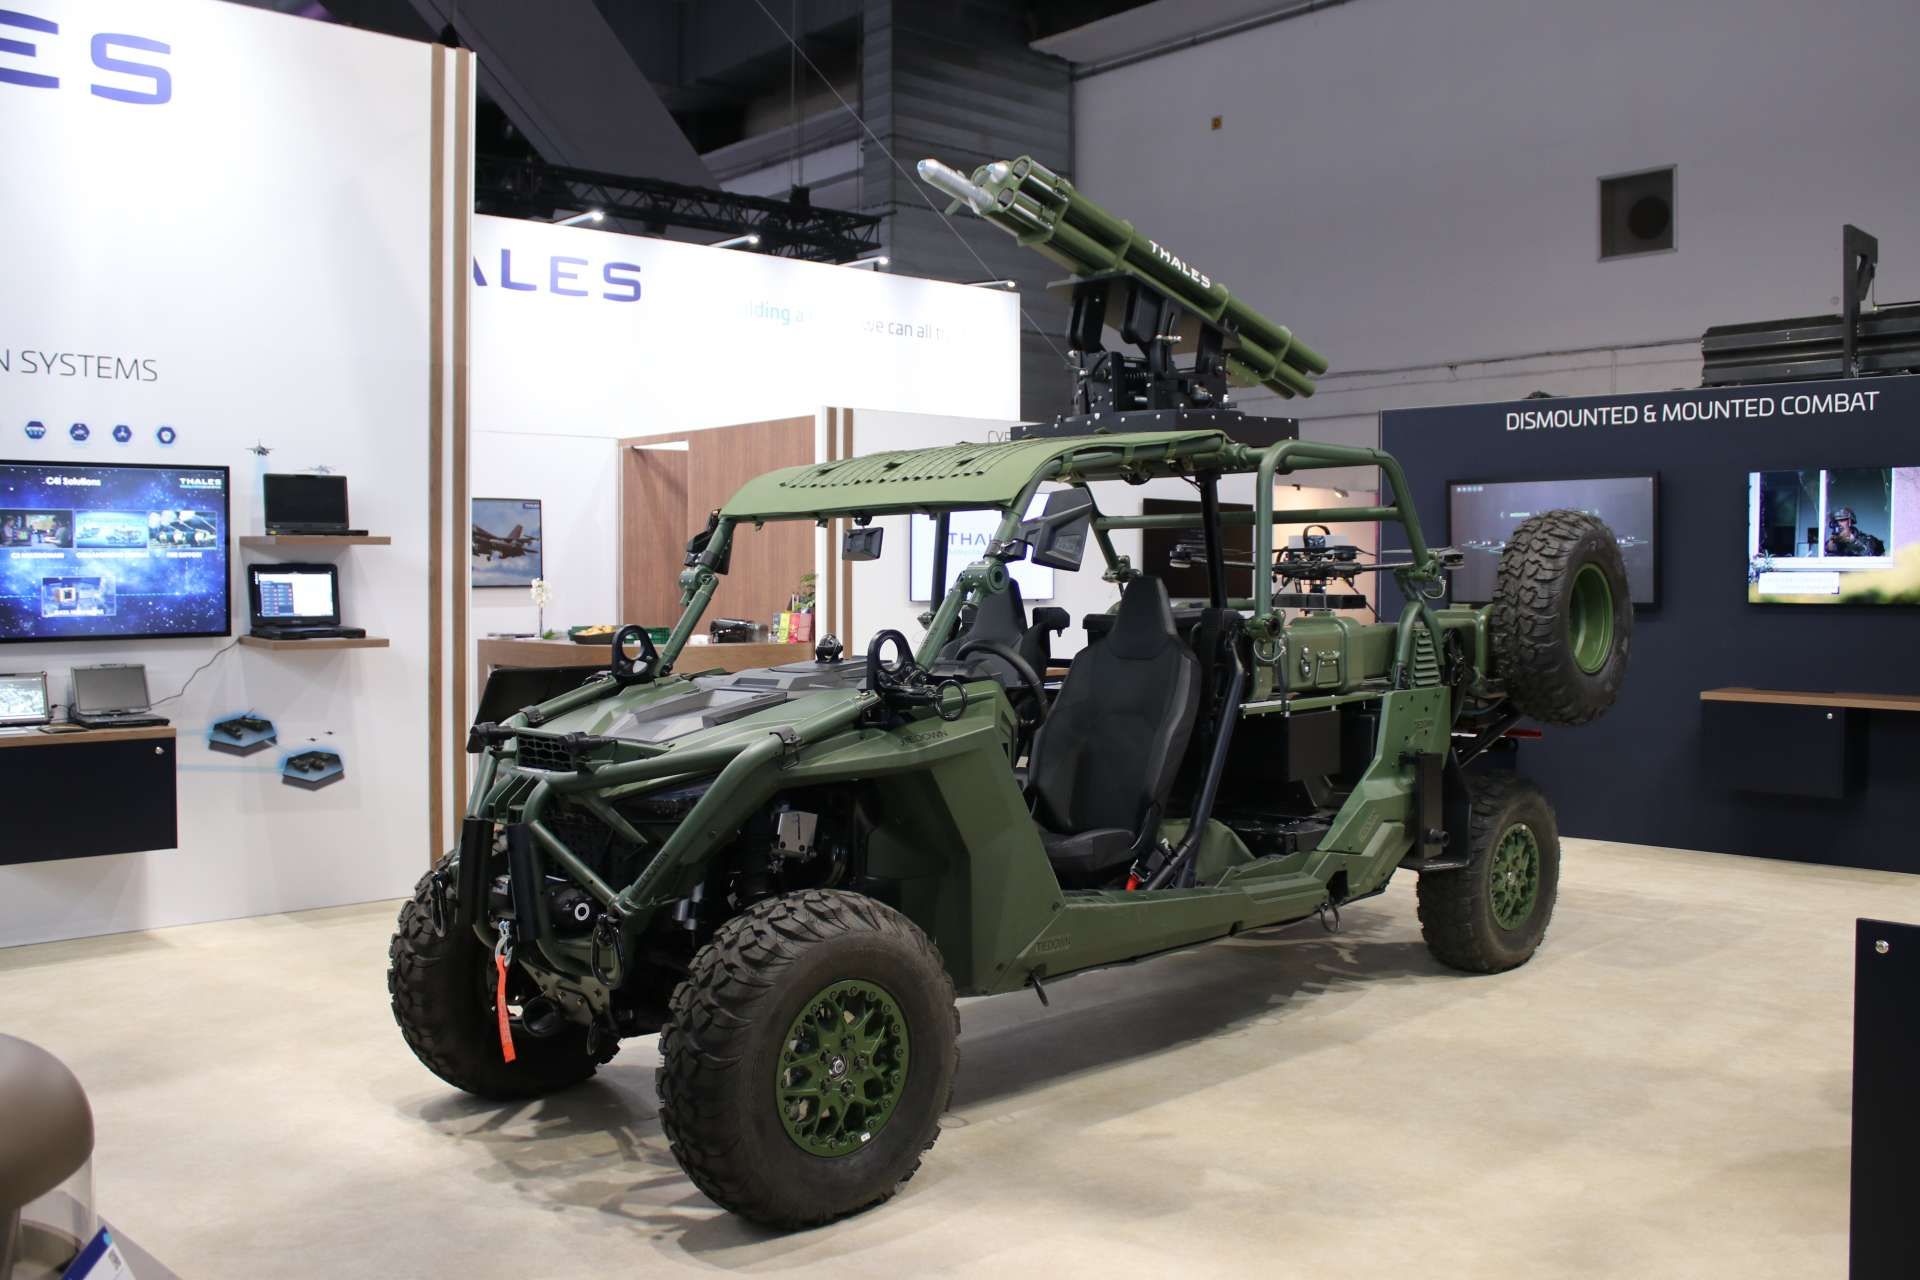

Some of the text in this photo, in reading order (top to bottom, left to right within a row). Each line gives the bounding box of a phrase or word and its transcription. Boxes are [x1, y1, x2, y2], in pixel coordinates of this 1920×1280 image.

[1148, 240, 1211, 289] THALES
[888, 321, 913, 337] can
[916, 322, 933, 339] all
[21, 350, 158, 382] SYSTEMS
[1506, 391, 1880, 431] DISMOUNTED & MOUNTED COMBAT
[63, 476, 101, 487] Solutions
[179, 477, 222, 485] THALES
